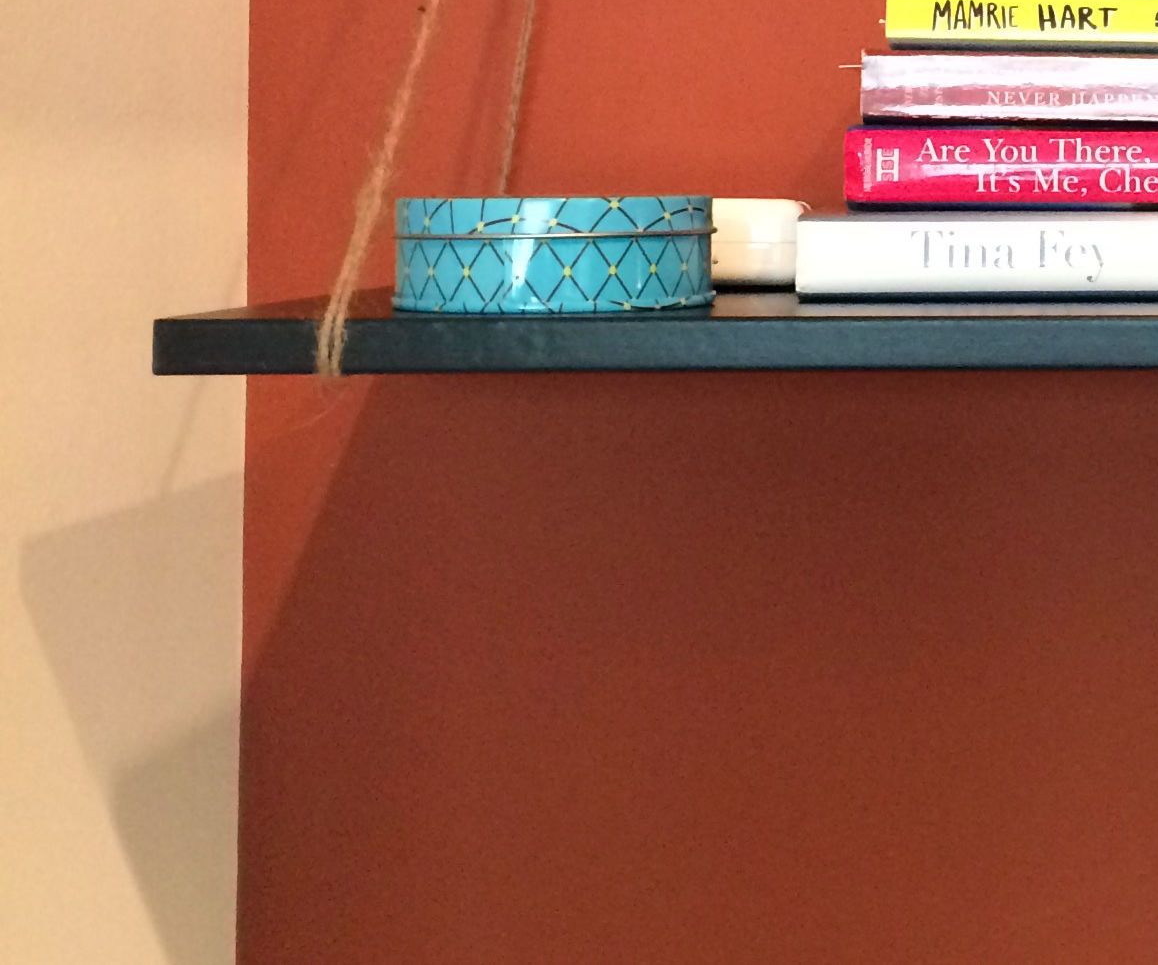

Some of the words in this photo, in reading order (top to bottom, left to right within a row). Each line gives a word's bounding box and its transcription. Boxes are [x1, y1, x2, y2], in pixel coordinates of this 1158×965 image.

[932, 0, 1018, 31] MAMRIE
[1038, 3, 1118, 31] HART
[986, 90, 1061, 106] NEVER
[916, 137, 971, 163] Are
[985, 137, 1038, 164] You
[1049, 137, 1151, 166] There,
[975, 170, 1021, 194] It's
[1032, 170, 1088, 197] Me,
[911, 230, 1014, 269] Tina
[1039, 230, 1104, 283] Fey
